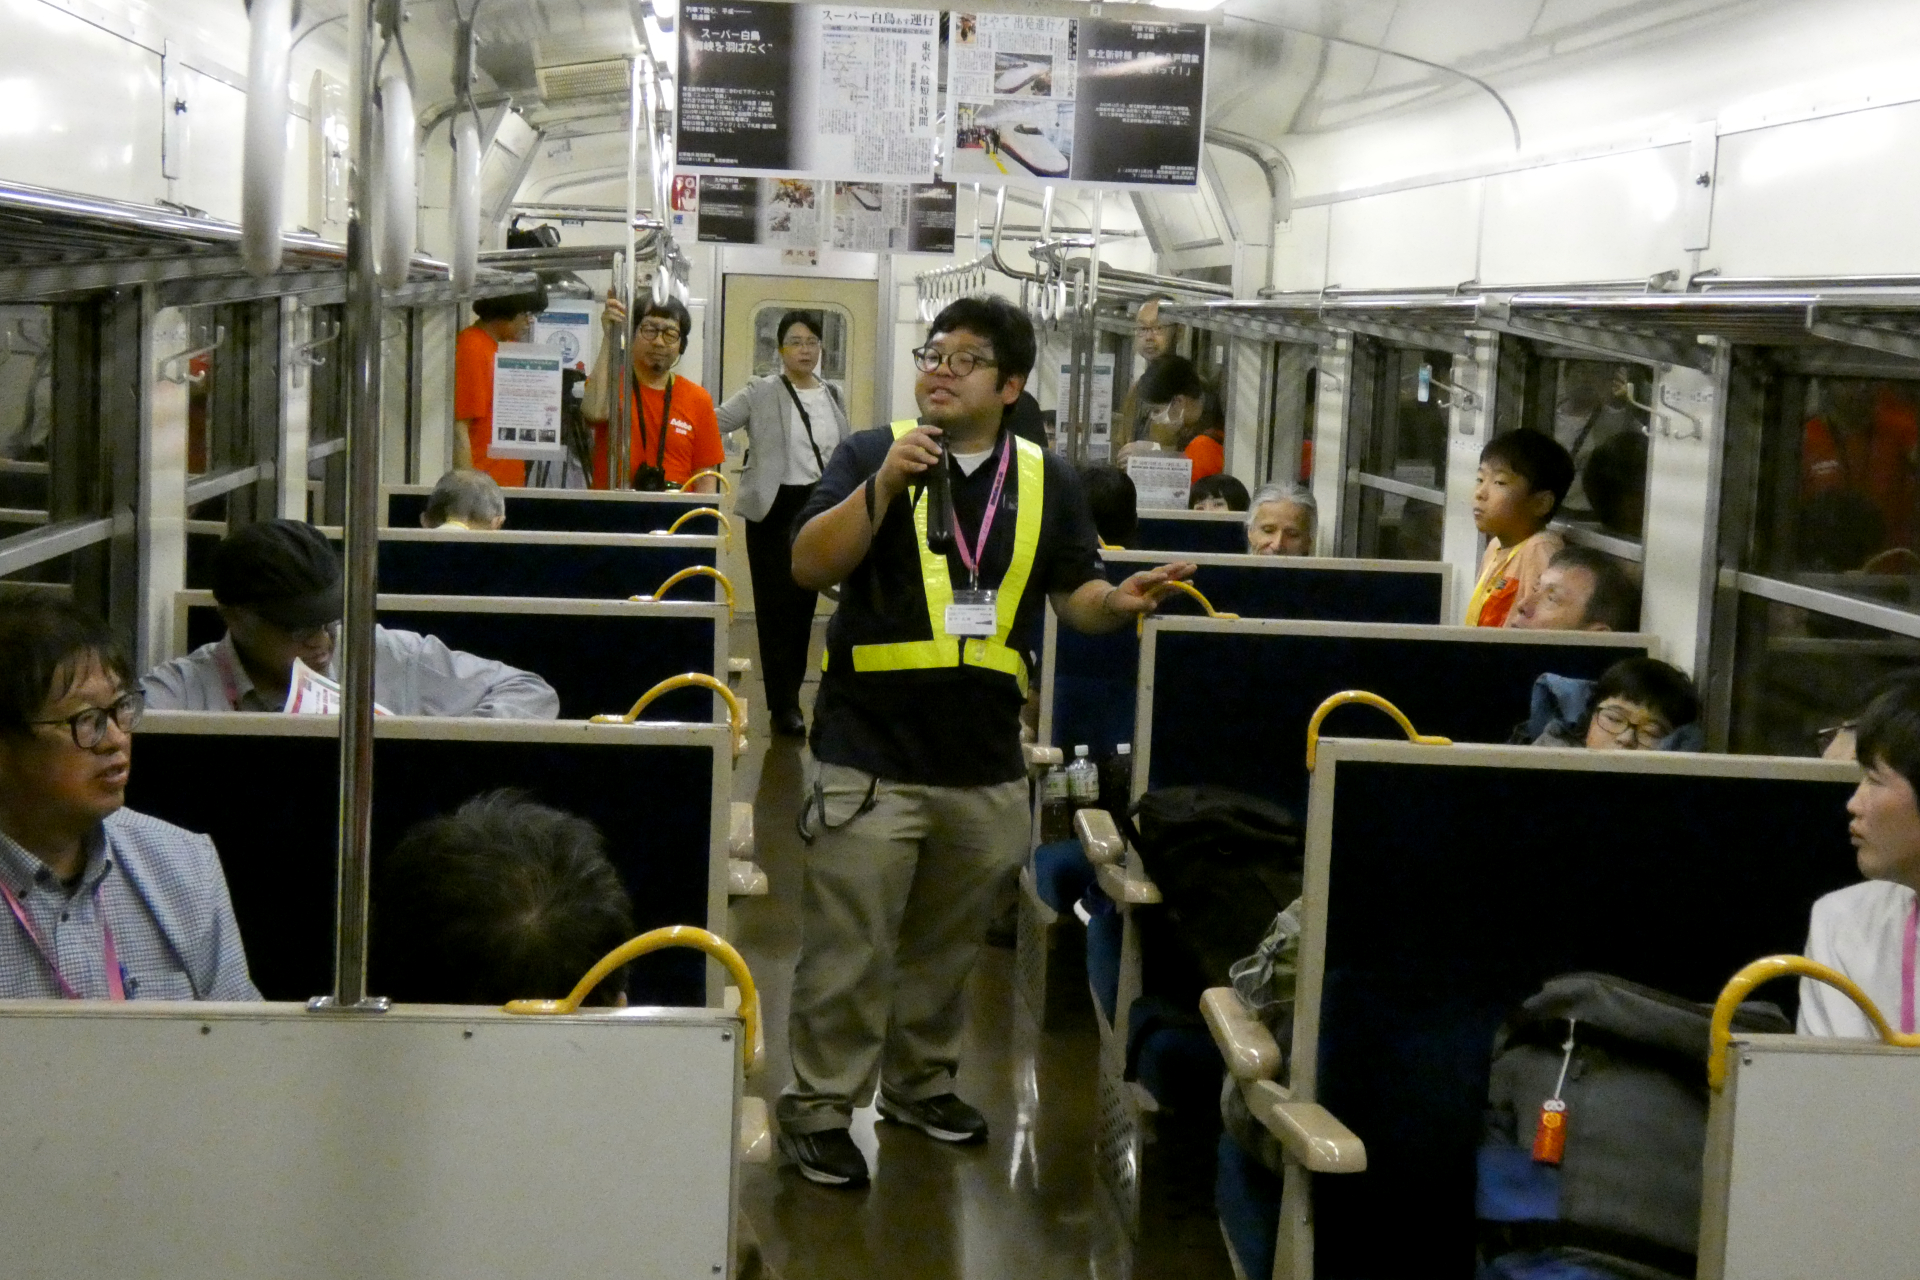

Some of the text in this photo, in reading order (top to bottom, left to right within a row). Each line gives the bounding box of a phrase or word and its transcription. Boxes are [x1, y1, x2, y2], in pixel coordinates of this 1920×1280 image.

[822, 10, 935, 27] スーパー白鳥あす運行
[701, 28, 761, 41] スーパー白鳥
